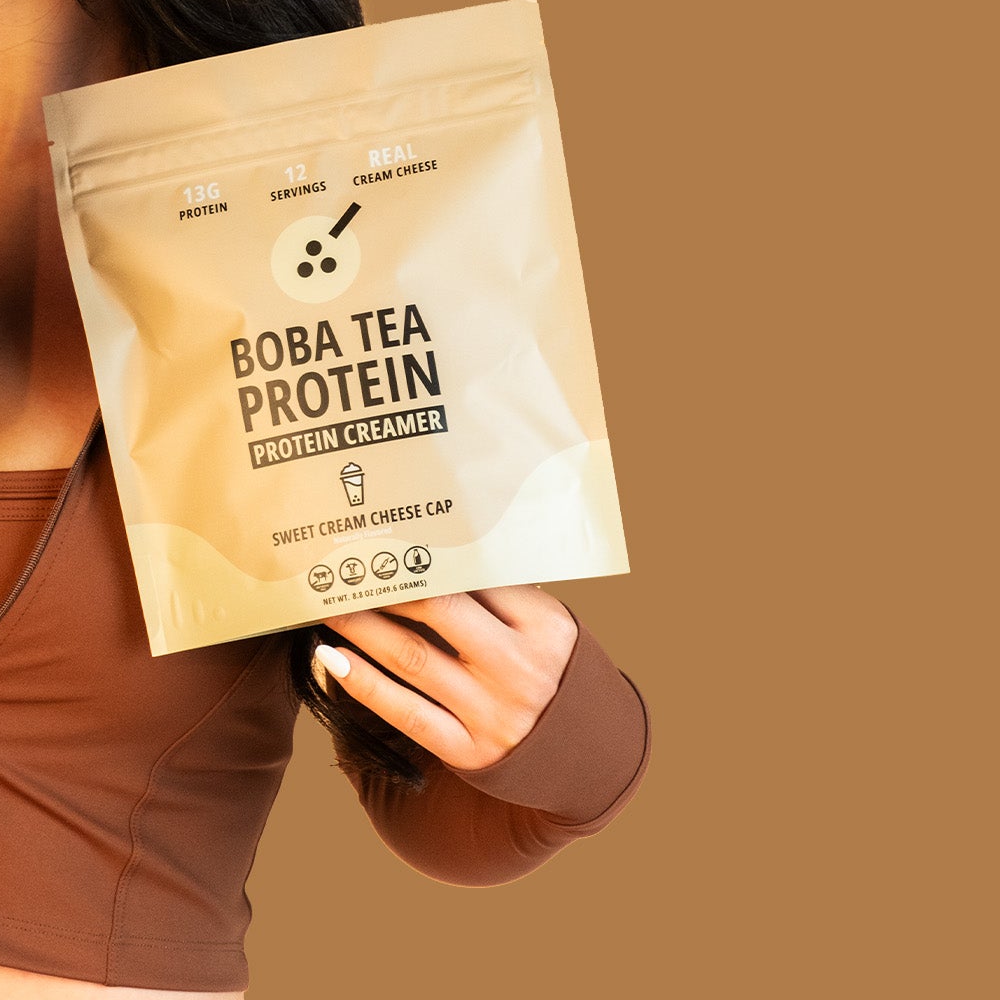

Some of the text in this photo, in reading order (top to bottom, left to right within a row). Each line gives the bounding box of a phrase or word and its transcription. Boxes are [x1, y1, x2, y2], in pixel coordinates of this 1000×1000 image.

[368, 143, 418, 168] REAL
[284, 164, 307, 183] 12
[353, 159, 438, 186] CREAM CHEESE
[183, 182, 220, 204] 13G
[270, 181, 327, 201] SERVINGS
[179, 202, 228, 221] PROTEIN
[230, 304, 431, 379] BOBA TEA
[238, 350, 441, 433] PROTEIN
[253, 409, 444, 465] PROTEIN CREAMER
[272, 499, 453, 547] SWEET CREAM CHEESE CAP
[323, 579, 428, 606] NET WT. 8.8 OZ (249.6 GRAMS)
